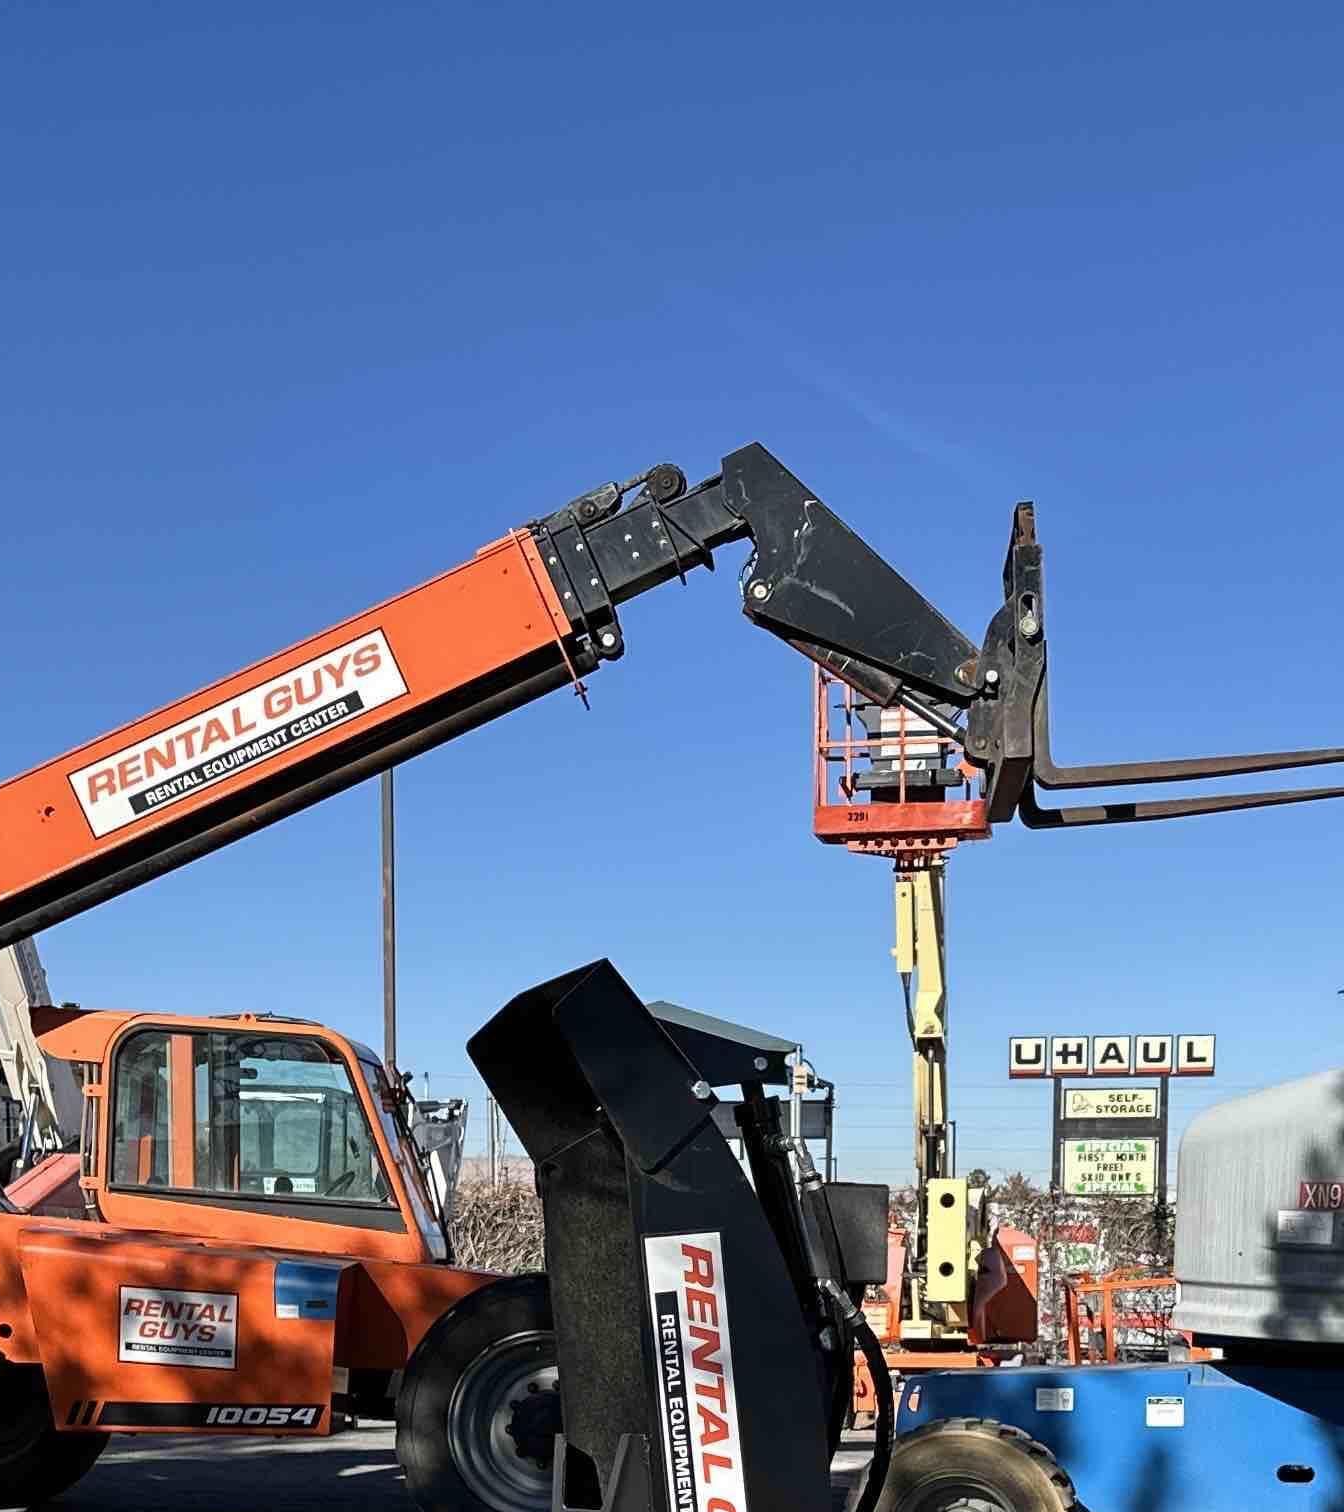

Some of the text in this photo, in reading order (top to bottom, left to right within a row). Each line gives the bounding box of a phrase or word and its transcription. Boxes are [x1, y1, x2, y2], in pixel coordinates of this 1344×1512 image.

[87, 643, 382, 804] RENTAL GUYS
[144, 701, 350, 806] RENTAL EQUIPMENT CENTER
[1095, 1104, 1153, 1114] STORAGE
[1108, 1093, 1144, 1103] SELF-
[1077, 1152, 1147, 1162] FIRST MONTH
[123, 1298, 233, 1323] RENTAL
[138, 1320, 217, 1344] GUYS
[660, 1314, 682, 1393] RENTAL
[681, 1243, 733, 1484] RENTAL
[205, 1406, 318, 1426] 10054
